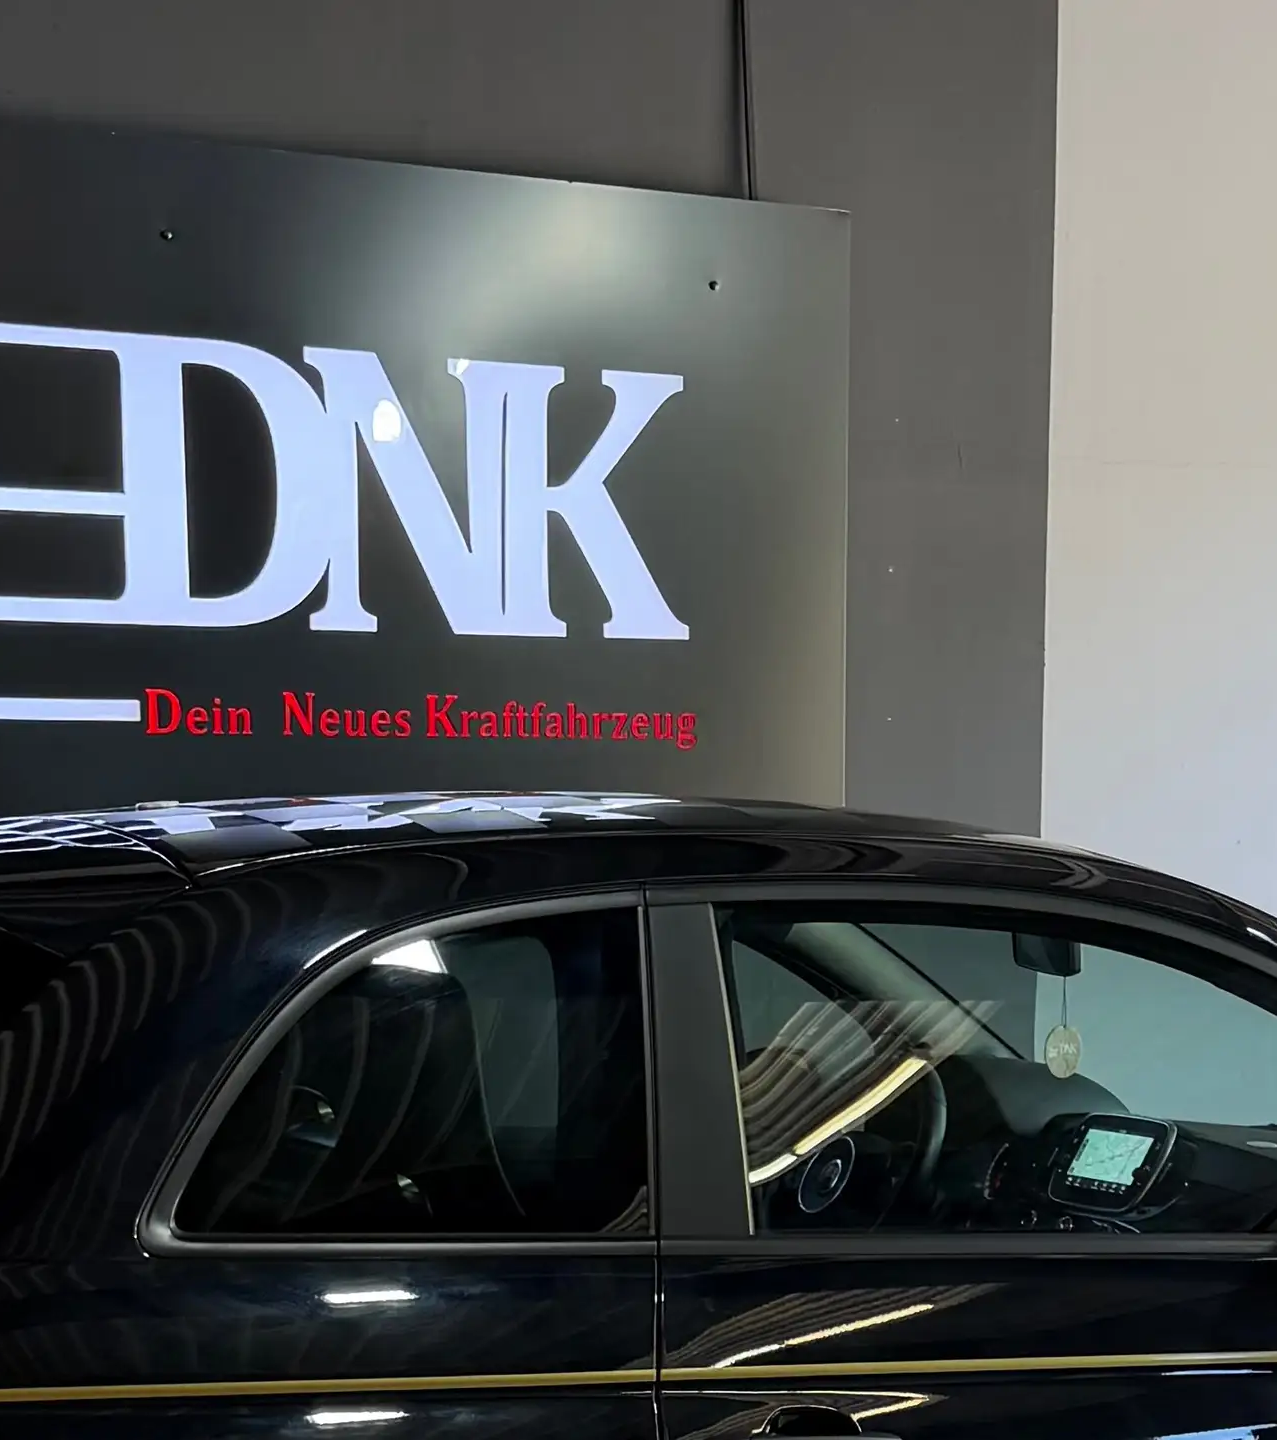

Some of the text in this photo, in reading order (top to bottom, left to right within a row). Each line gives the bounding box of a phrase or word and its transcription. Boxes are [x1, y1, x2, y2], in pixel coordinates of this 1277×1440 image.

[118, 334, 690, 641] DNK
[145, 688, 698, 750] Dein Neues Kraftfahrzeug
